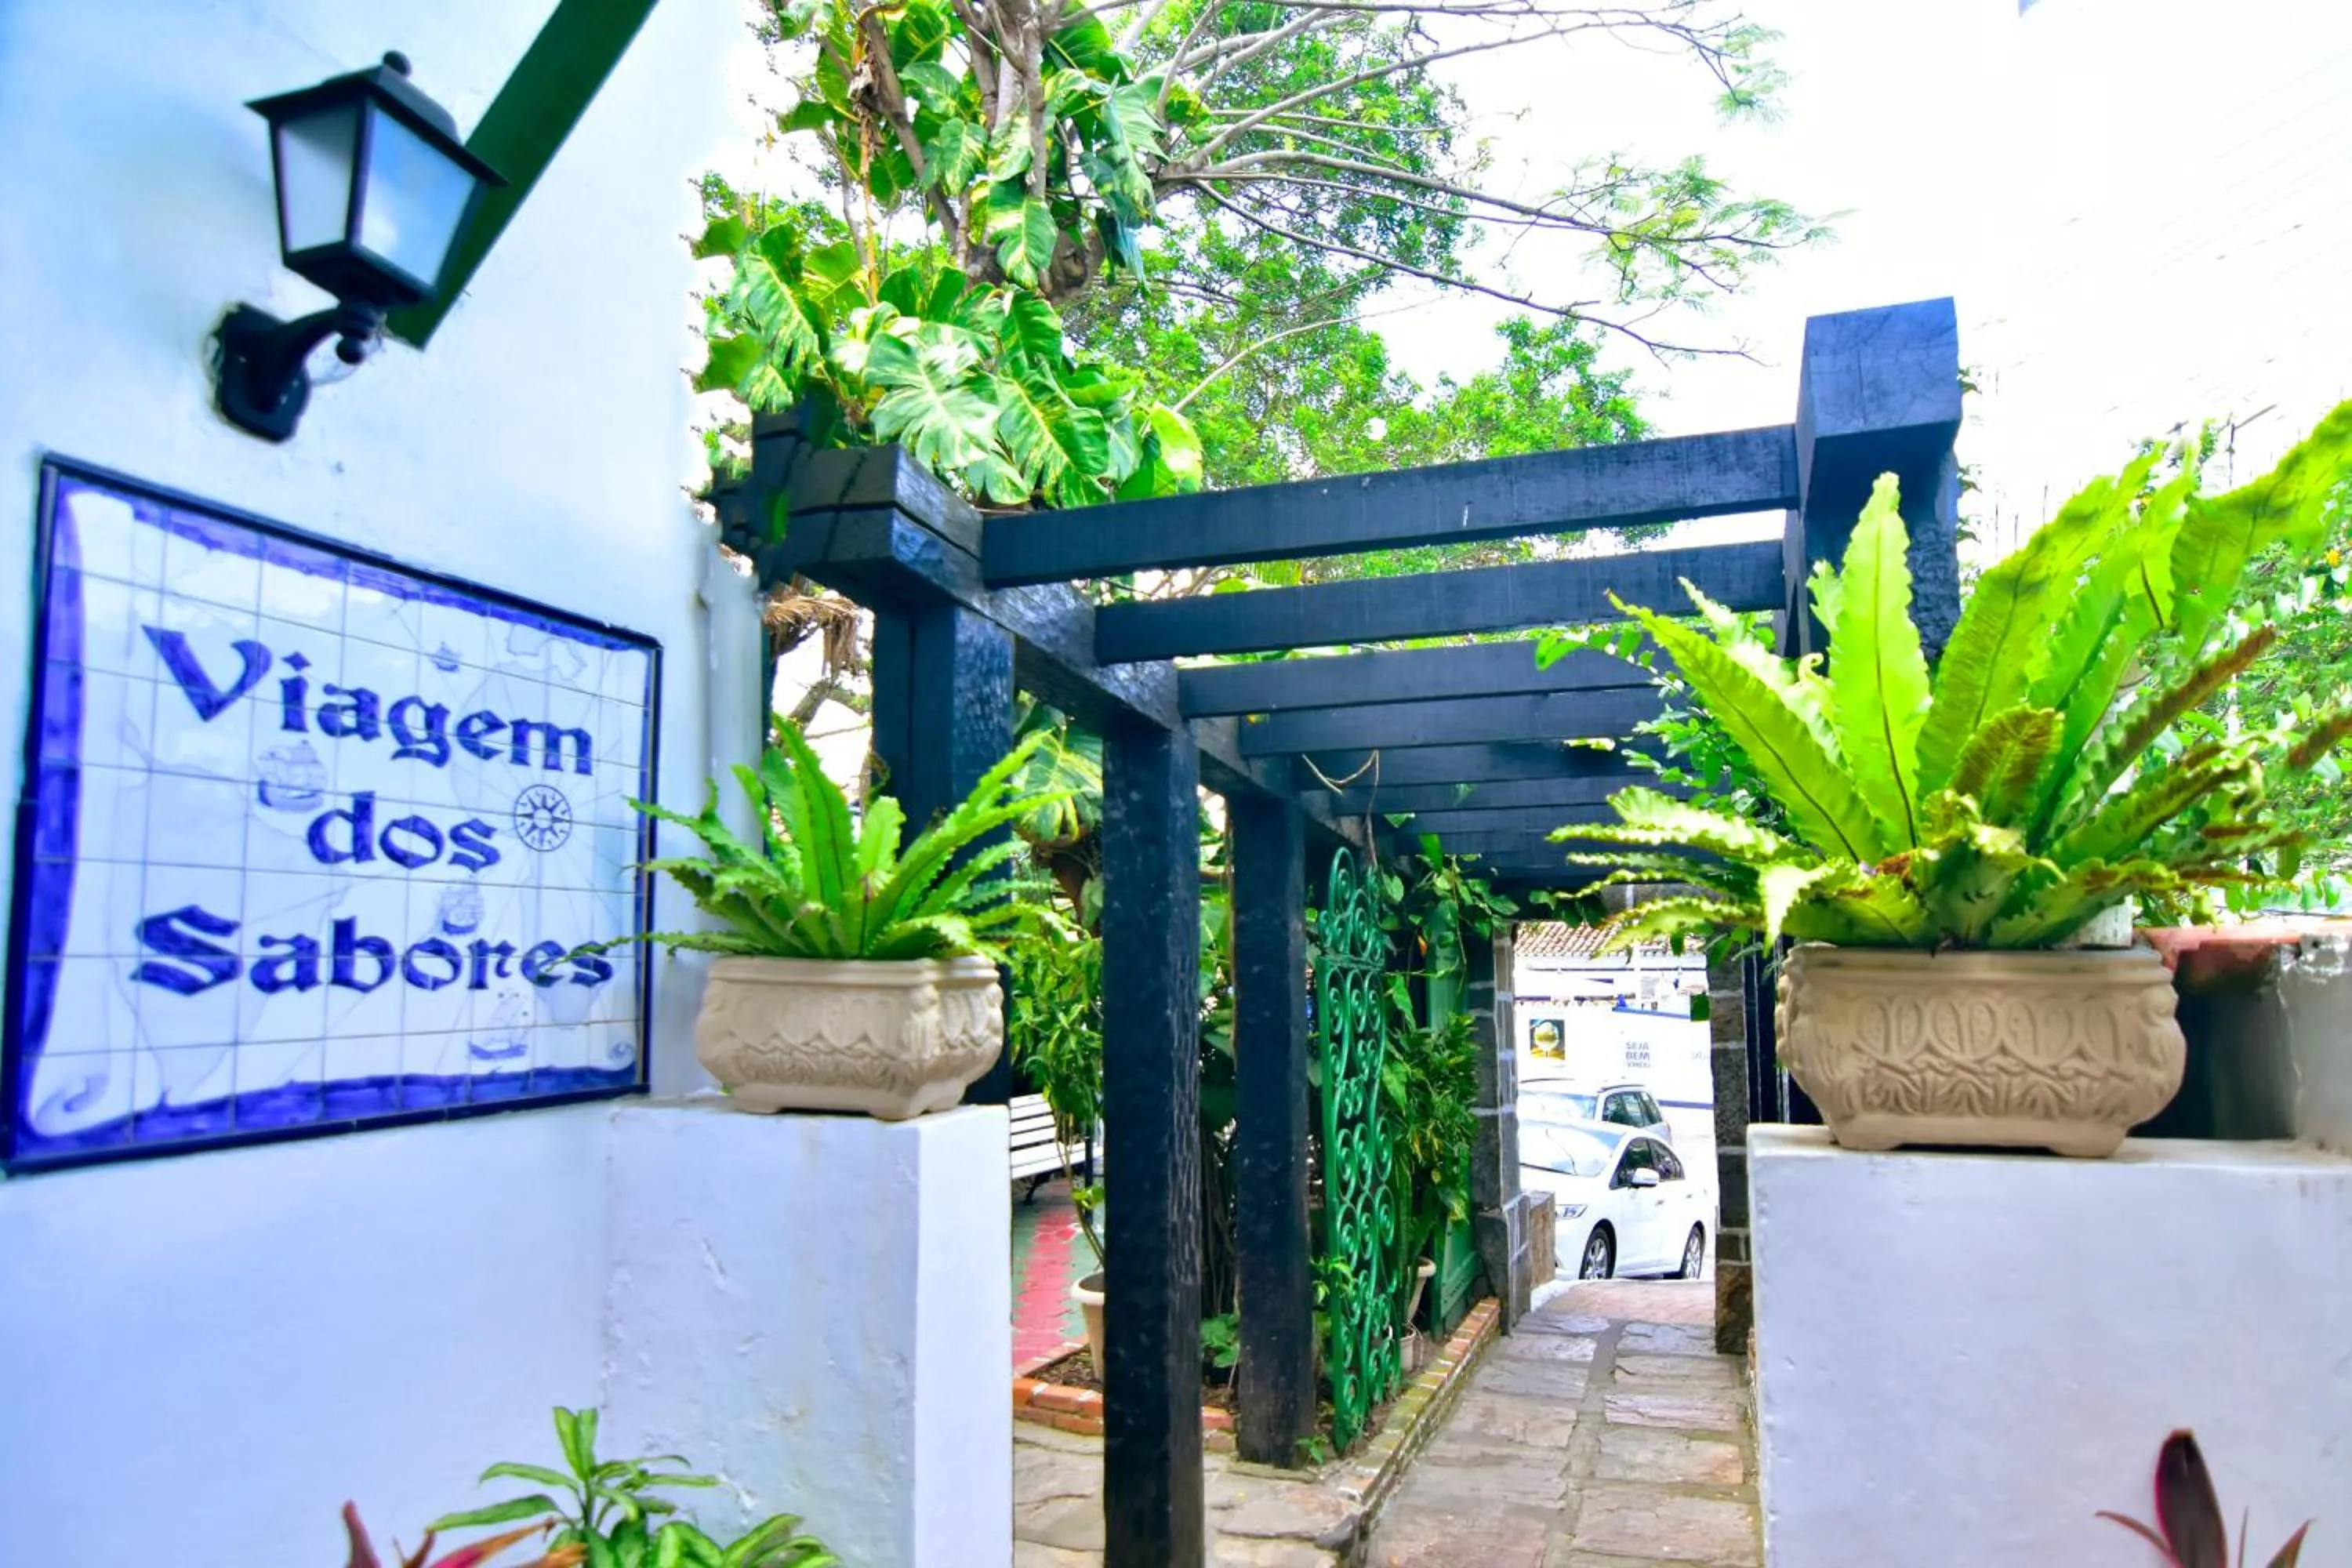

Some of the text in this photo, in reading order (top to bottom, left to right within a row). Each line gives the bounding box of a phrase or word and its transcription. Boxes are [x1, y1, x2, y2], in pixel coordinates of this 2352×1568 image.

[141, 625, 593, 775] Viagem
[307, 791, 502, 873] dos
[129, 905, 615, 996] Sabores
